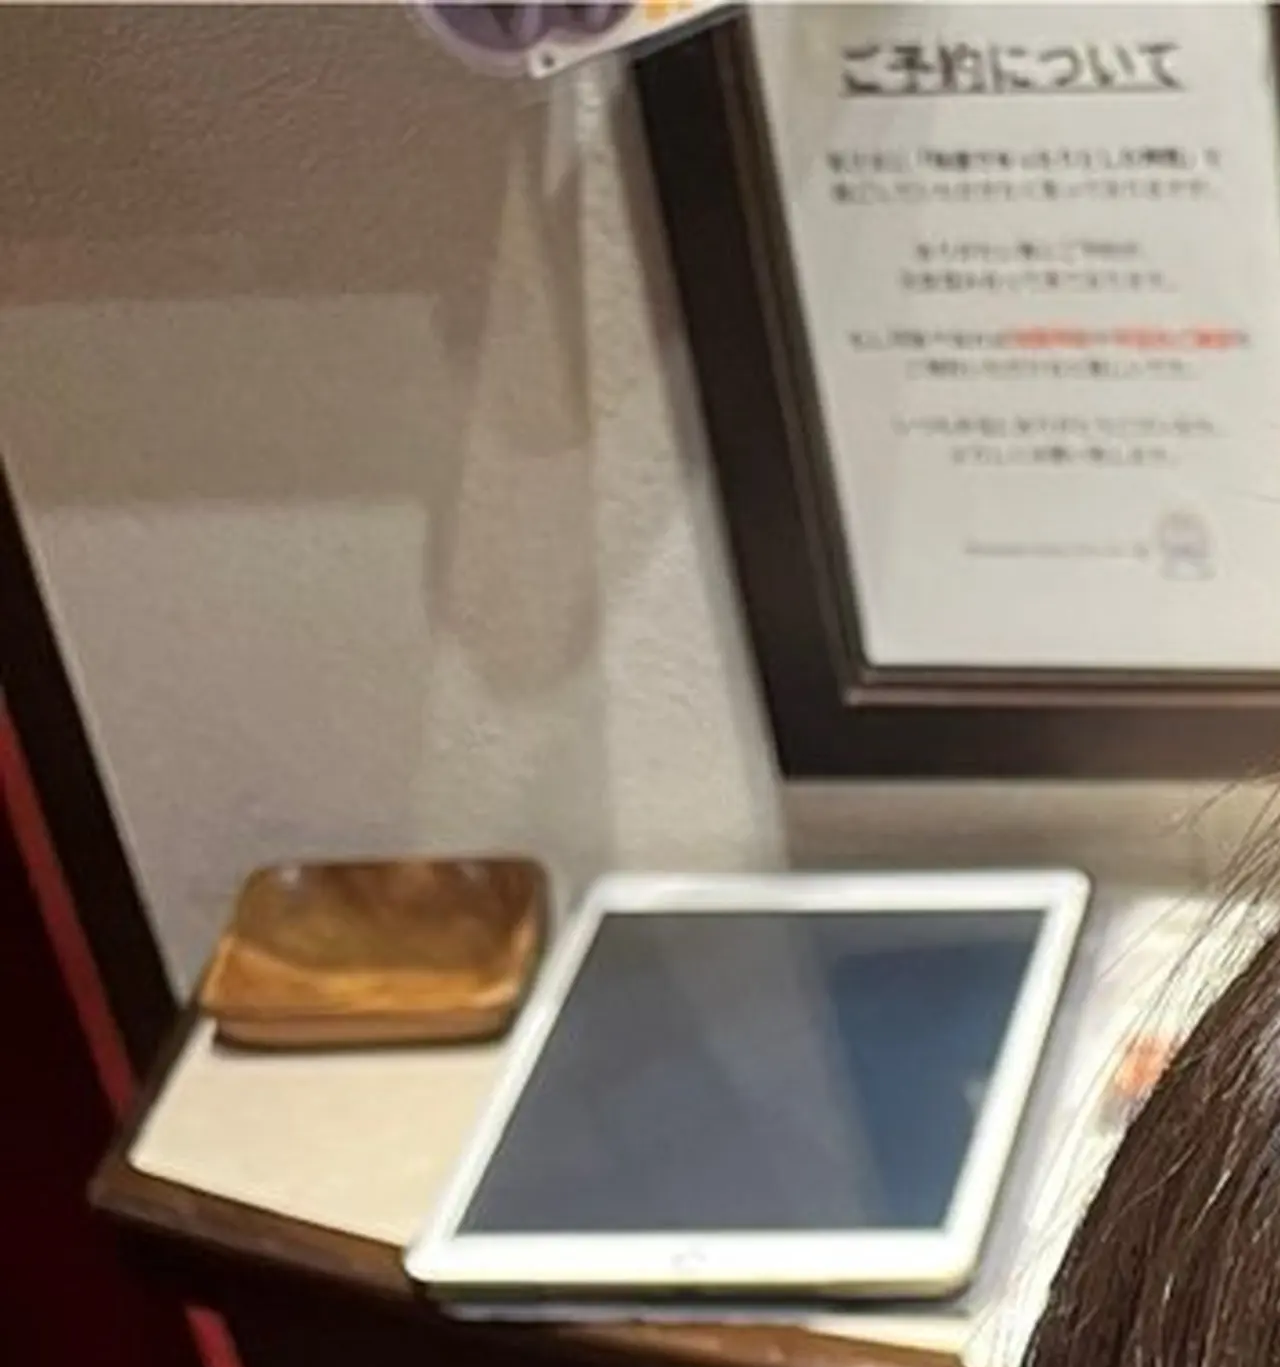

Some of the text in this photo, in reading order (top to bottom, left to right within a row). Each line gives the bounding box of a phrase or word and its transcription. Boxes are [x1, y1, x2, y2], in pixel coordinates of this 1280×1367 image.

[841, 42, 1182, 92] ご予約について
